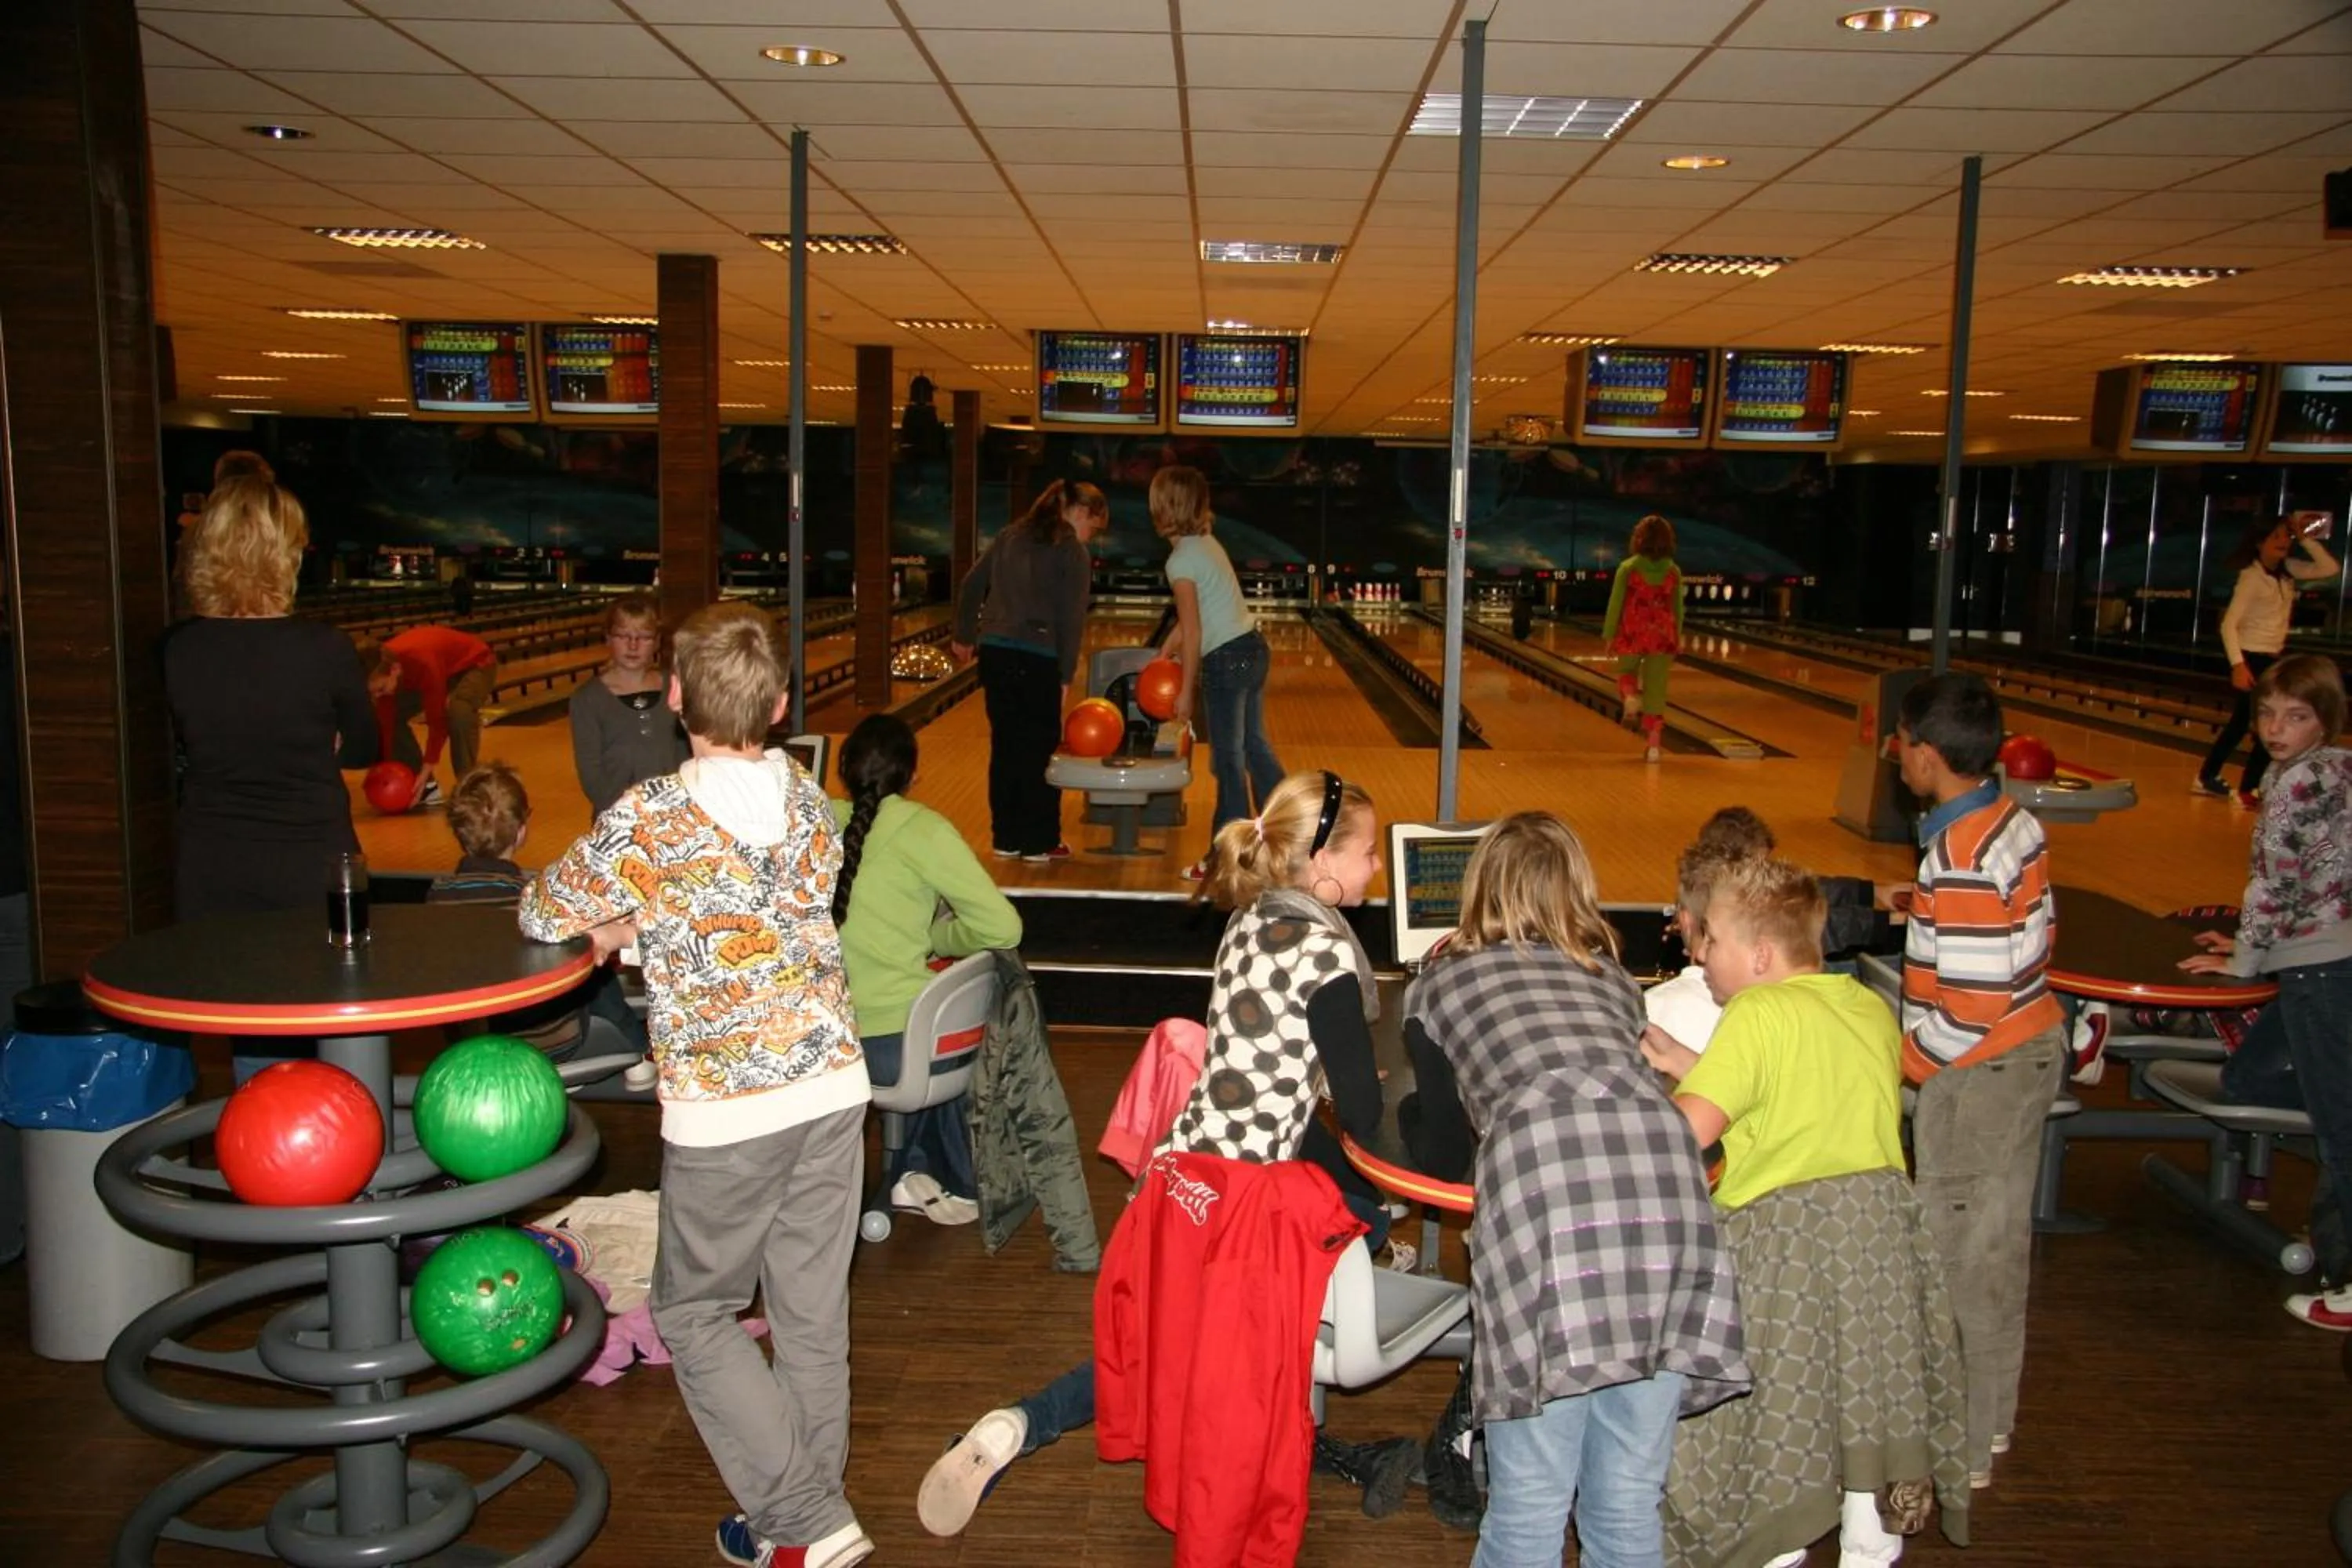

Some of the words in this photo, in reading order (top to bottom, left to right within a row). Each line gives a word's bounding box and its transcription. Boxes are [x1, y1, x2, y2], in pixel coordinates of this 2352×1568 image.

[517, 547, 525, 557] 2
[535, 547, 543, 557] 3
[760, 552, 770, 562] 4
[1553, 570, 1567, 580] 10
